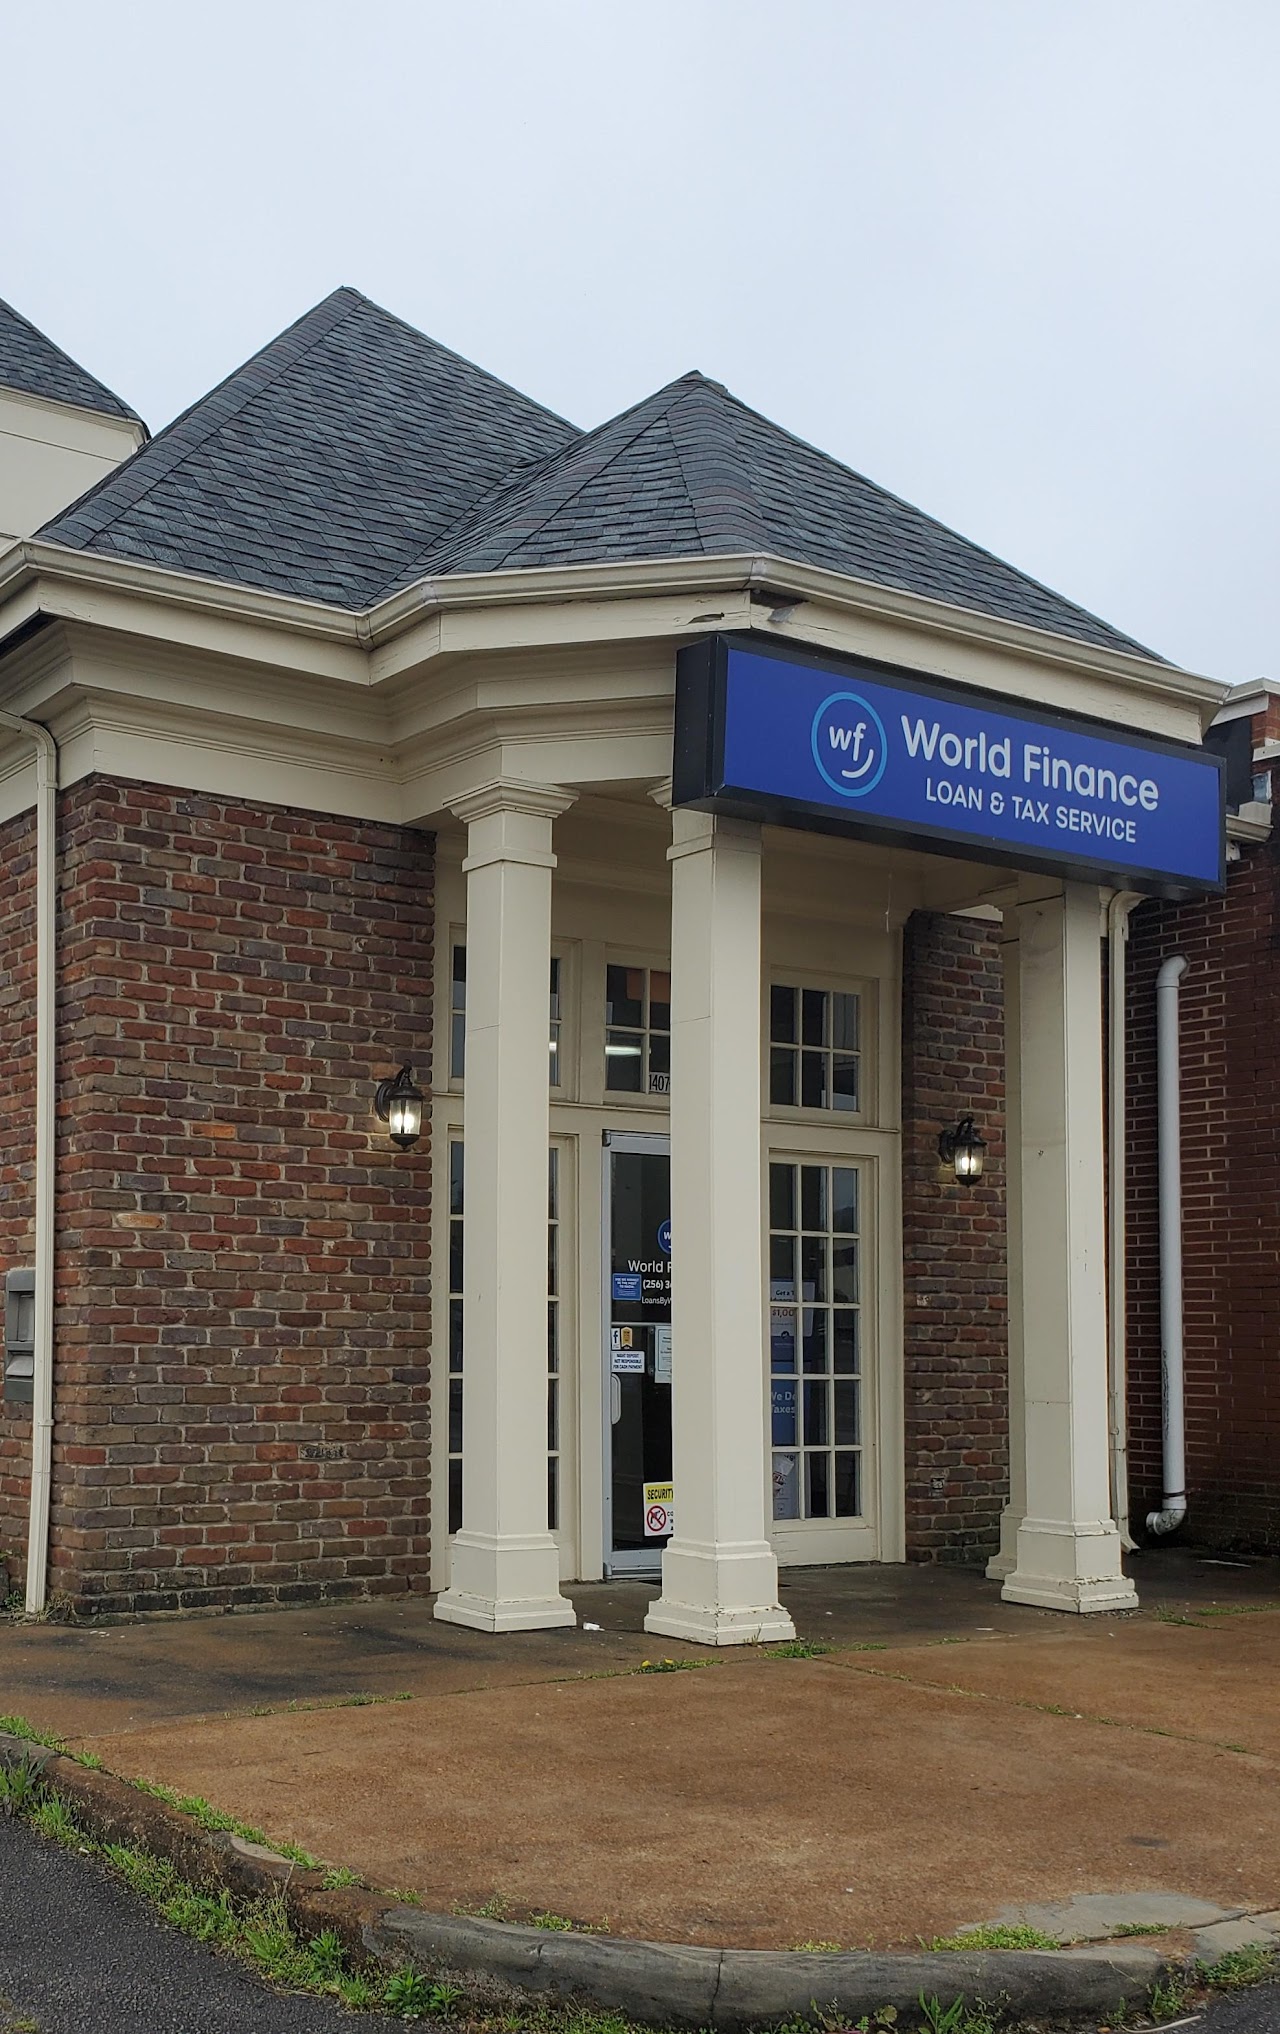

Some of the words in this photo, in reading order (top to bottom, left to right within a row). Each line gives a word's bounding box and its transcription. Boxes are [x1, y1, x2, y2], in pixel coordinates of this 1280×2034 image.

[901, 715, 1011, 778] World
[1023, 743, 1159, 811] Finance
[926, 777, 983, 812] LOAN
[989, 792, 1005, 816] &
[1011, 796, 1049, 826] TAX
[1055, 806, 1137, 844] SERVICE
[627, 1260, 664, 1273] World
[642, 1279, 664, 1291] (256)
